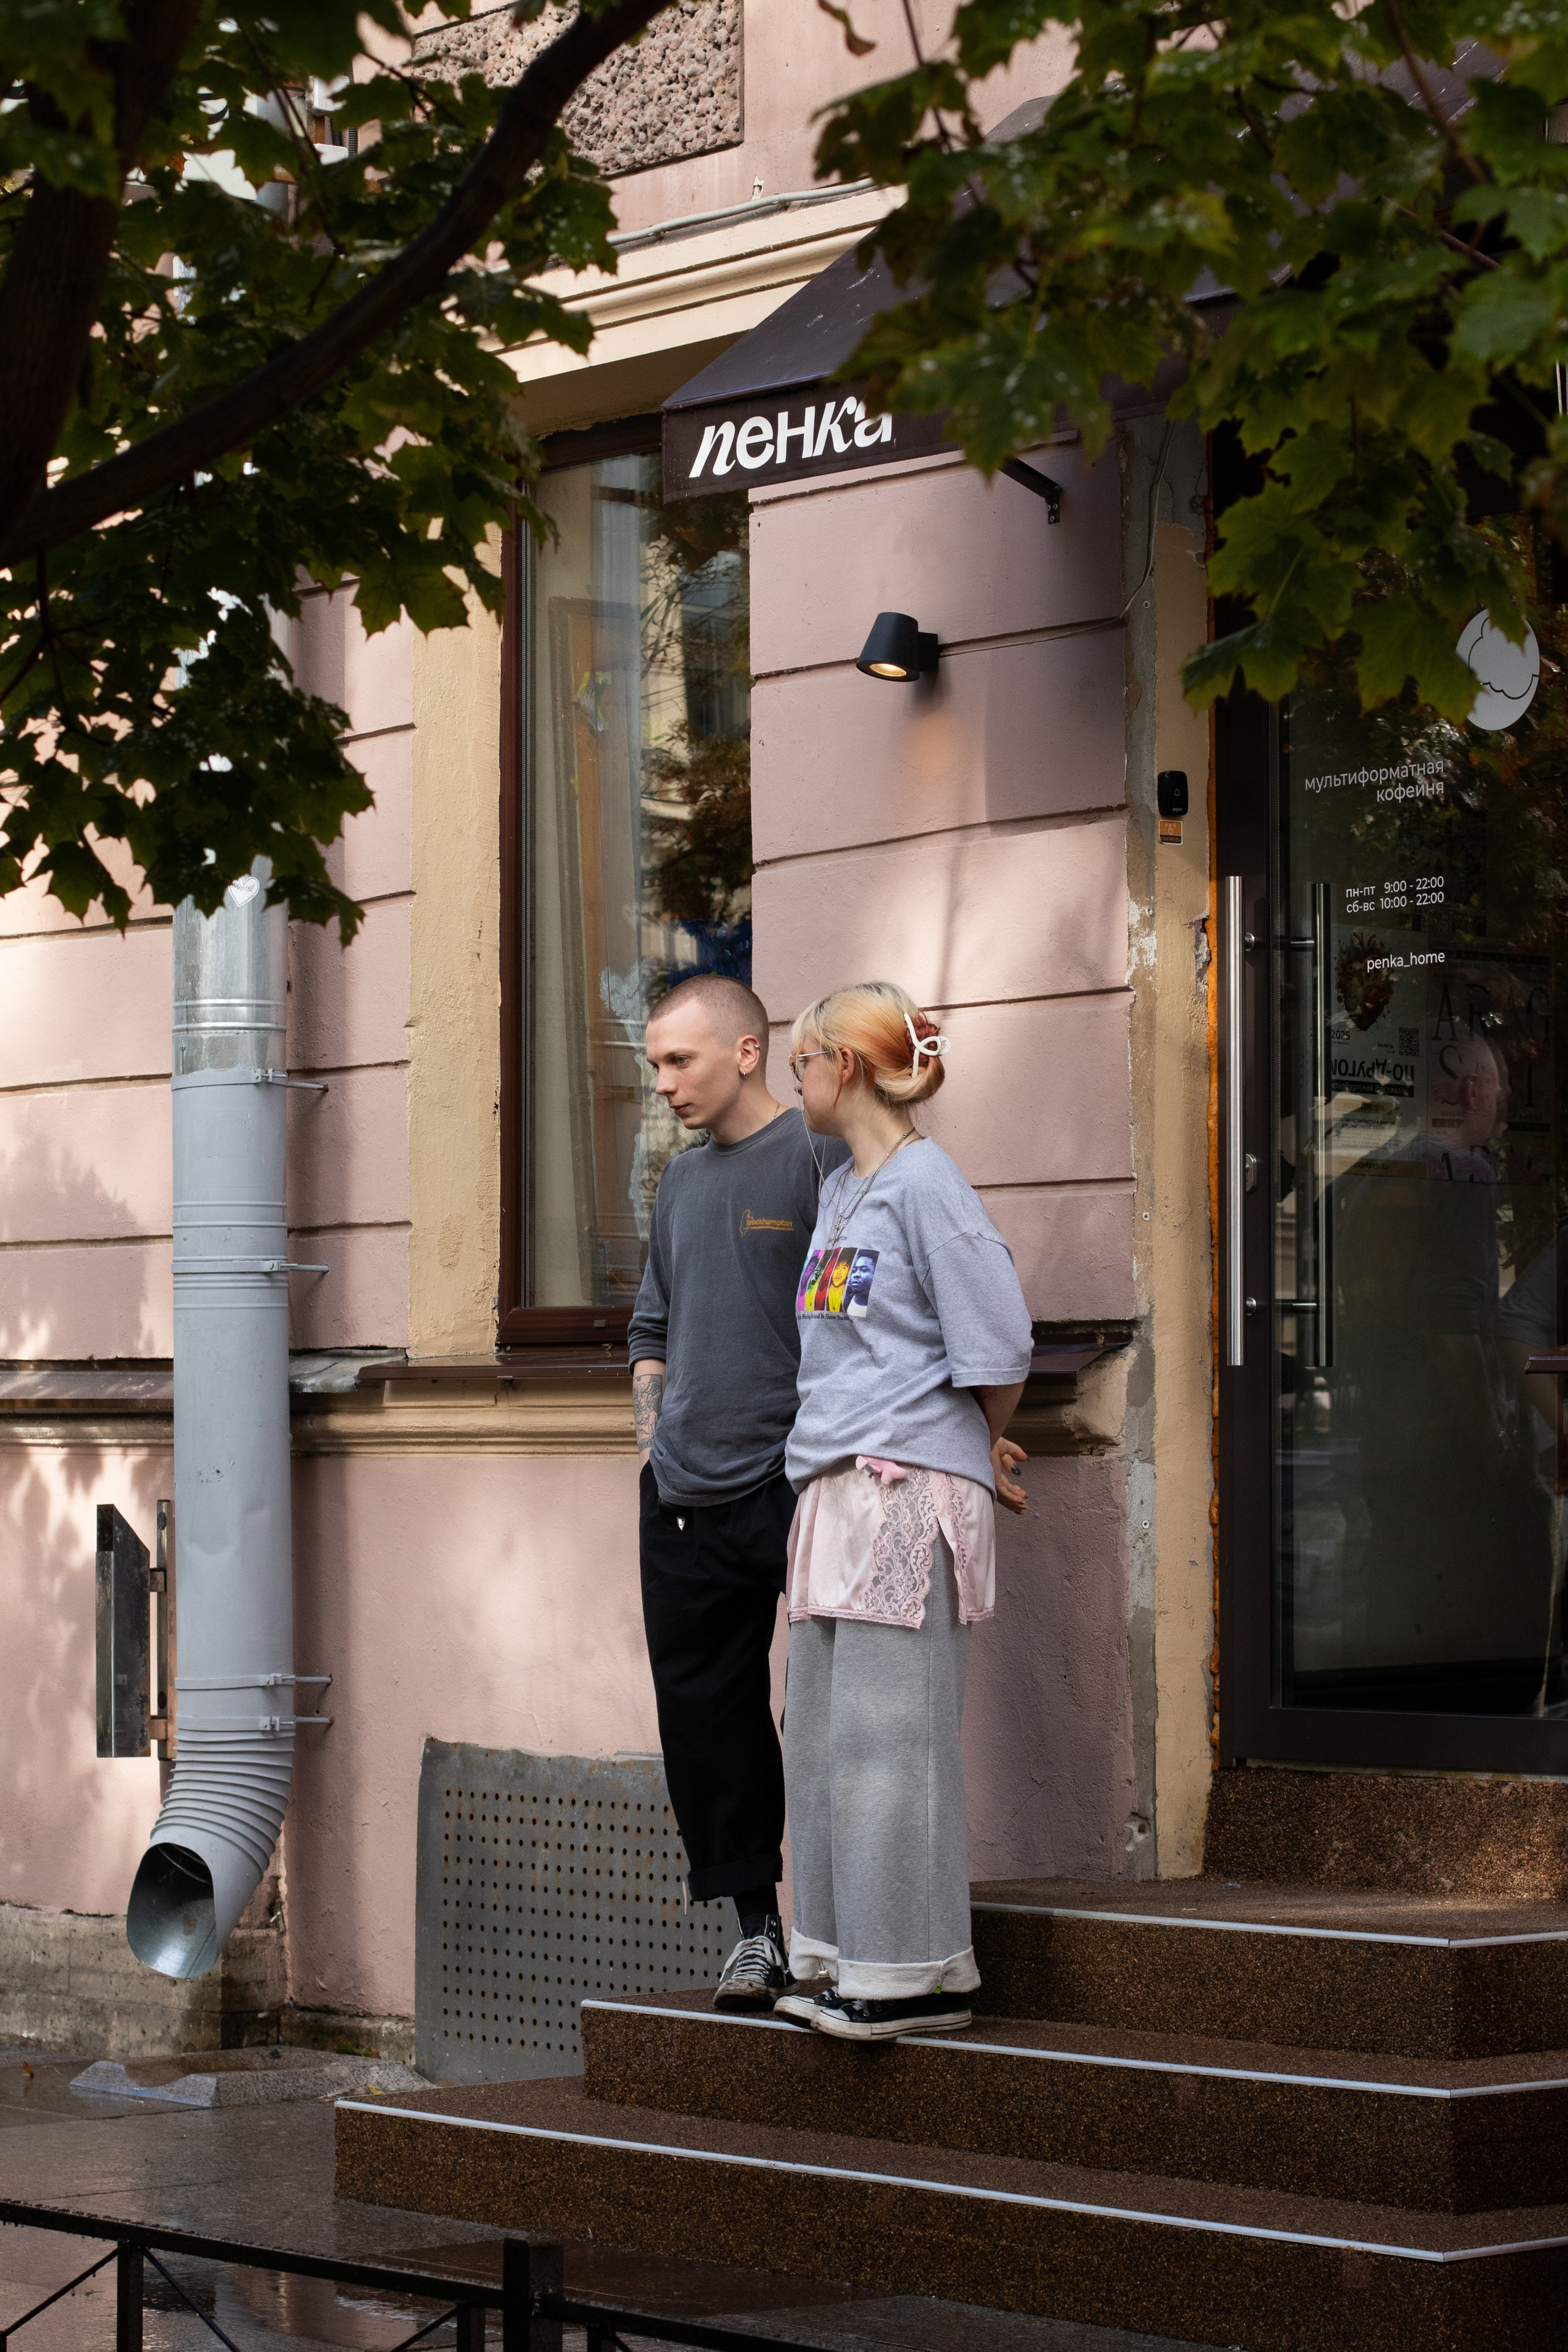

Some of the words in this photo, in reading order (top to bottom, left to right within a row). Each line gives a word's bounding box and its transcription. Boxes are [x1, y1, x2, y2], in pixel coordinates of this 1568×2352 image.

[1305, 760, 1444, 793] мультиформатная
[1377, 780, 1444, 803] кофейня
[1346, 885, 1376, 898] пн-пт
[1384, 881, 1407, 894] 9:00
[1415, 876, 1444, 891] 22:00
[1346, 900, 1375, 913] сб-вс
[1381, 896, 1407, 910] 10:00
[1415, 891, 1444, 906] 22:00
[1367, 951, 1445, 973] penka_home
